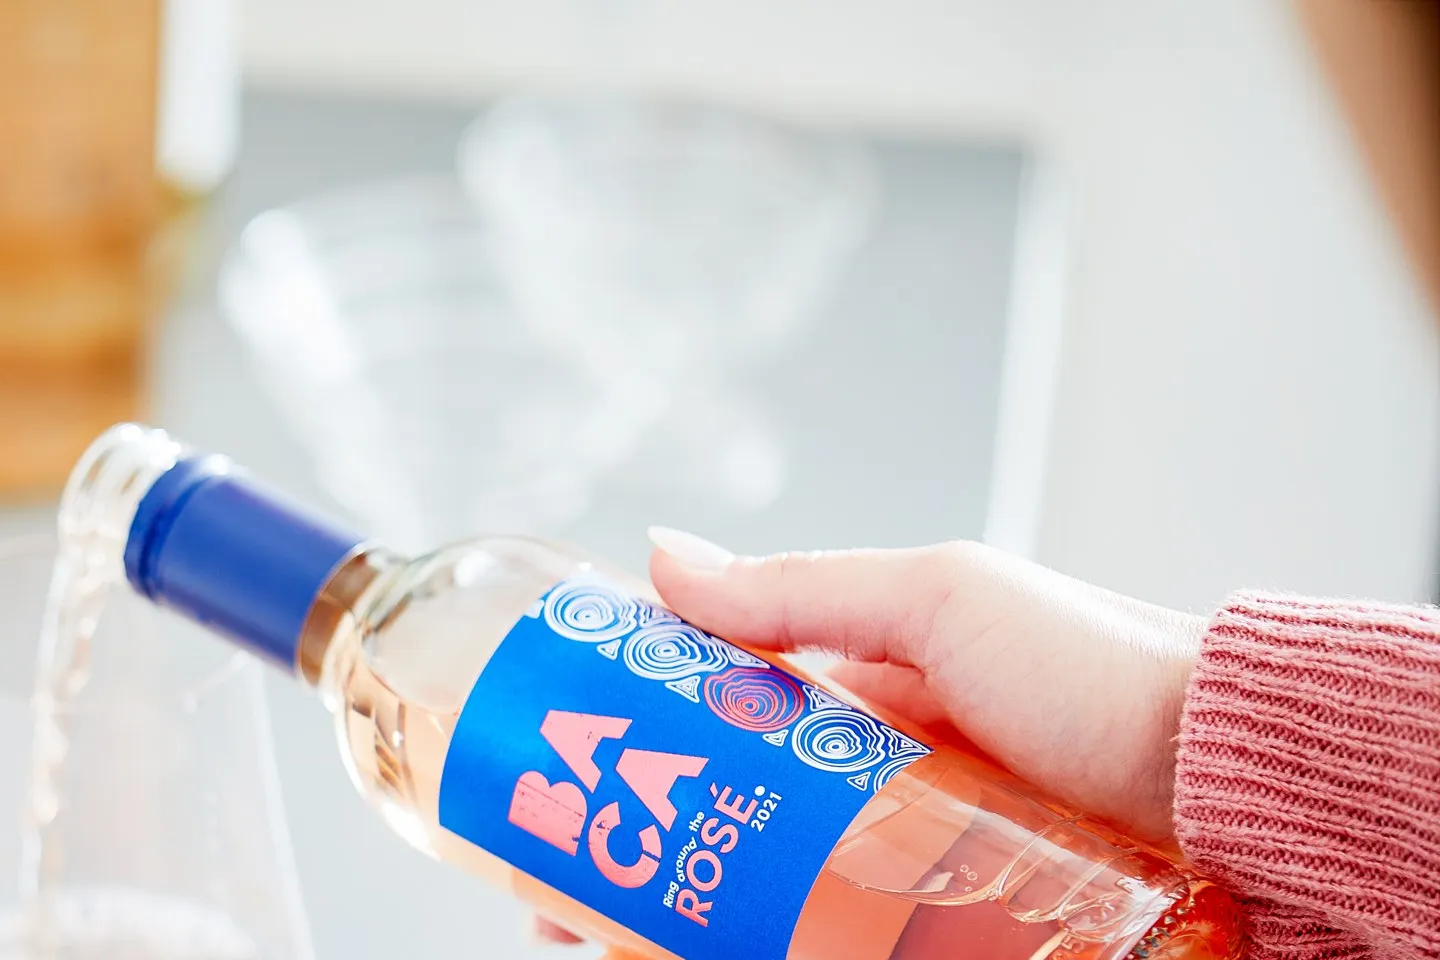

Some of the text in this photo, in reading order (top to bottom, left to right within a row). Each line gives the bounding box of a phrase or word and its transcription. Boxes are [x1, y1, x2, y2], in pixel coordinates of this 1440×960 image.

[507, 709, 633, 857] BA
[587, 747, 710, 889] CA
[750, 791, 783, 833] 2021
[662, 811, 705, 908] Ring around the
